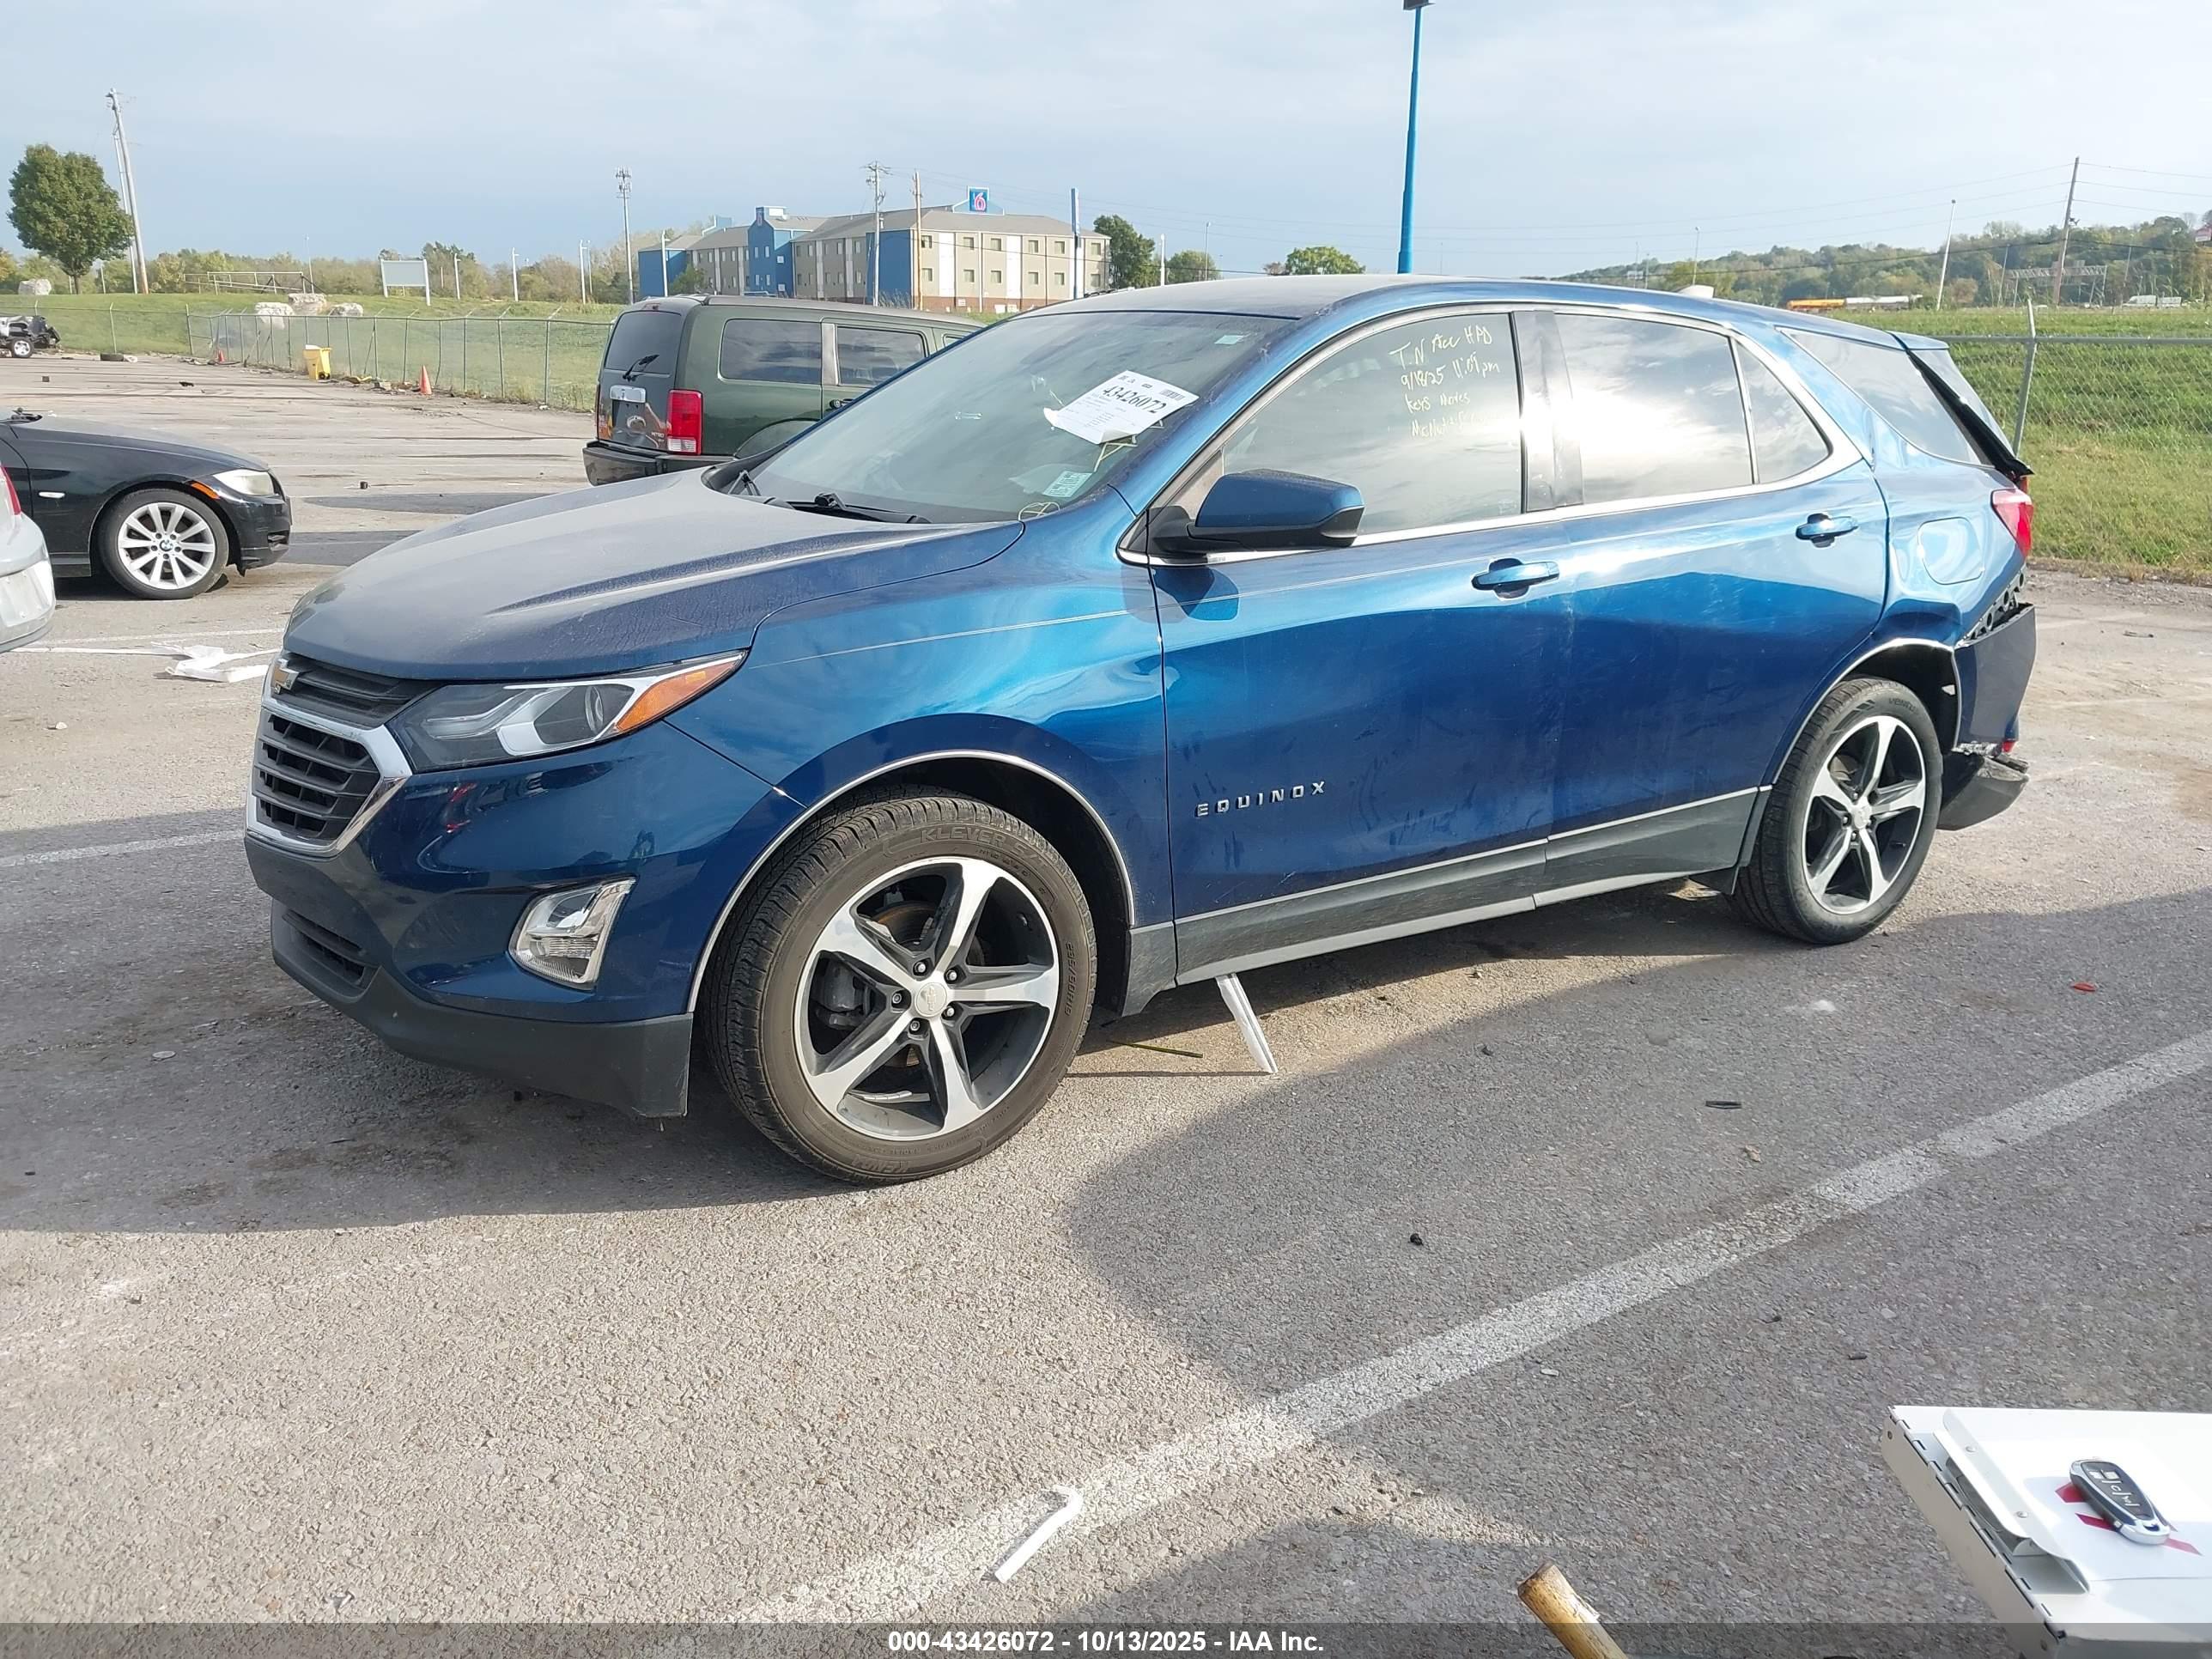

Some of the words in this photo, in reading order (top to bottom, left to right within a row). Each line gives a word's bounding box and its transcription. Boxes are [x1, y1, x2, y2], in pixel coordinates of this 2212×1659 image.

[1103, 386, 1167, 414] 43426072
[1195, 781, 1325, 817] EQUINOX
[921, 826, 1006, 848] KLEVER
